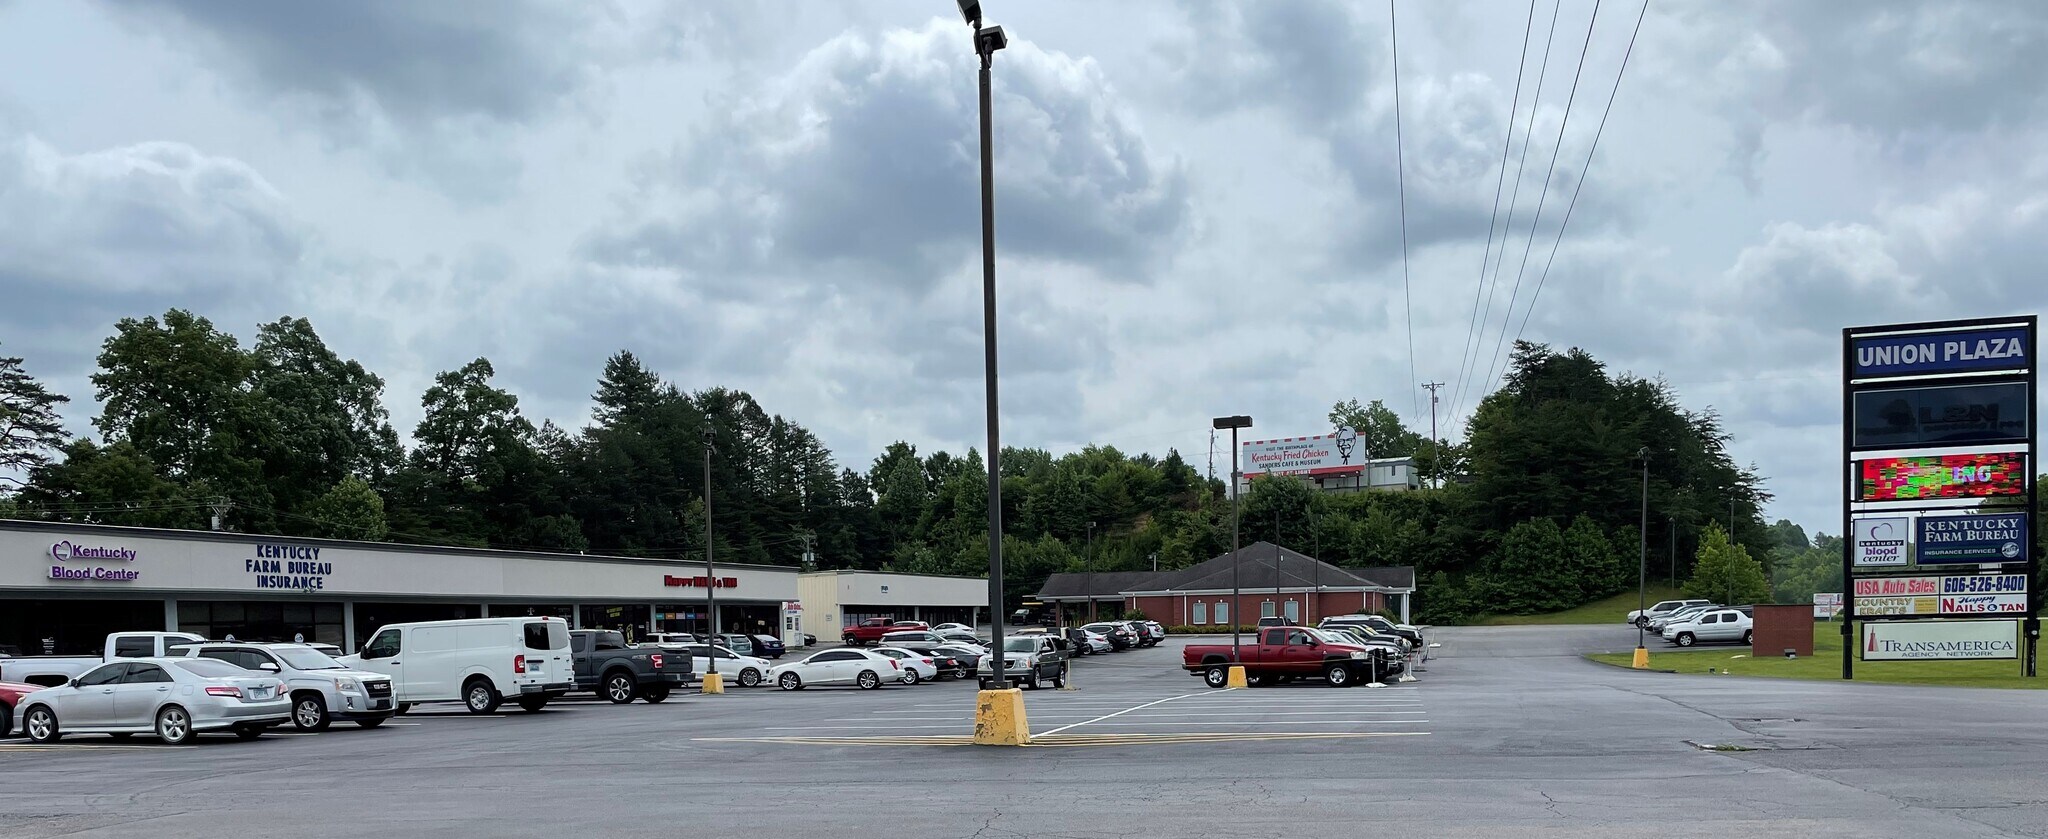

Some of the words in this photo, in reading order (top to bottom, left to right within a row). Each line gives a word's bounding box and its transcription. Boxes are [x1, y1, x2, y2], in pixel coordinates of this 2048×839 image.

[1857, 343, 1936, 367] UNION
[1944, 337, 2024, 361] PLAZA
[1251, 452, 1282, 463] Kentucky
[1283, 450, 1300, 460] Fried
[1301, 449, 1329, 459] Chicken
[1258, 461, 1281, 469] SANDERS
[1925, 518, 2019, 531] KENTUCKY
[1924, 531, 1963, 543] FARM
[1966, 529, 2019, 541] BUREAU
[72, 544, 136, 561] Kentucky
[256, 544, 320, 560] KENTUCKY
[1862, 554, 1899, 562] center
[1865, 547, 1897, 555] blood
[52, 566, 91, 579] Blood
[95, 567, 140, 580] Center
[245, 559, 281, 574] FARM
[288, 561, 332, 575] BUREAU
[256, 575, 323, 589] INSURANCE
[1856, 581, 1879, 595] USA
[1882, 580, 1906, 594] Auto
[1908, 579, 1936, 593] Sales
[1944, 576, 2025, 593] 606-526-8400
[1854, 597, 1912, 607] KOUNTRY
[1942, 598, 1985, 612] NAILS
[1999, 603, 2025, 611] TAN
[1958, 596, 1996, 604] Happy
[1859, 606, 1907, 616] KRAFTS
[1880, 640, 2013, 652] TRANSAMERICA
